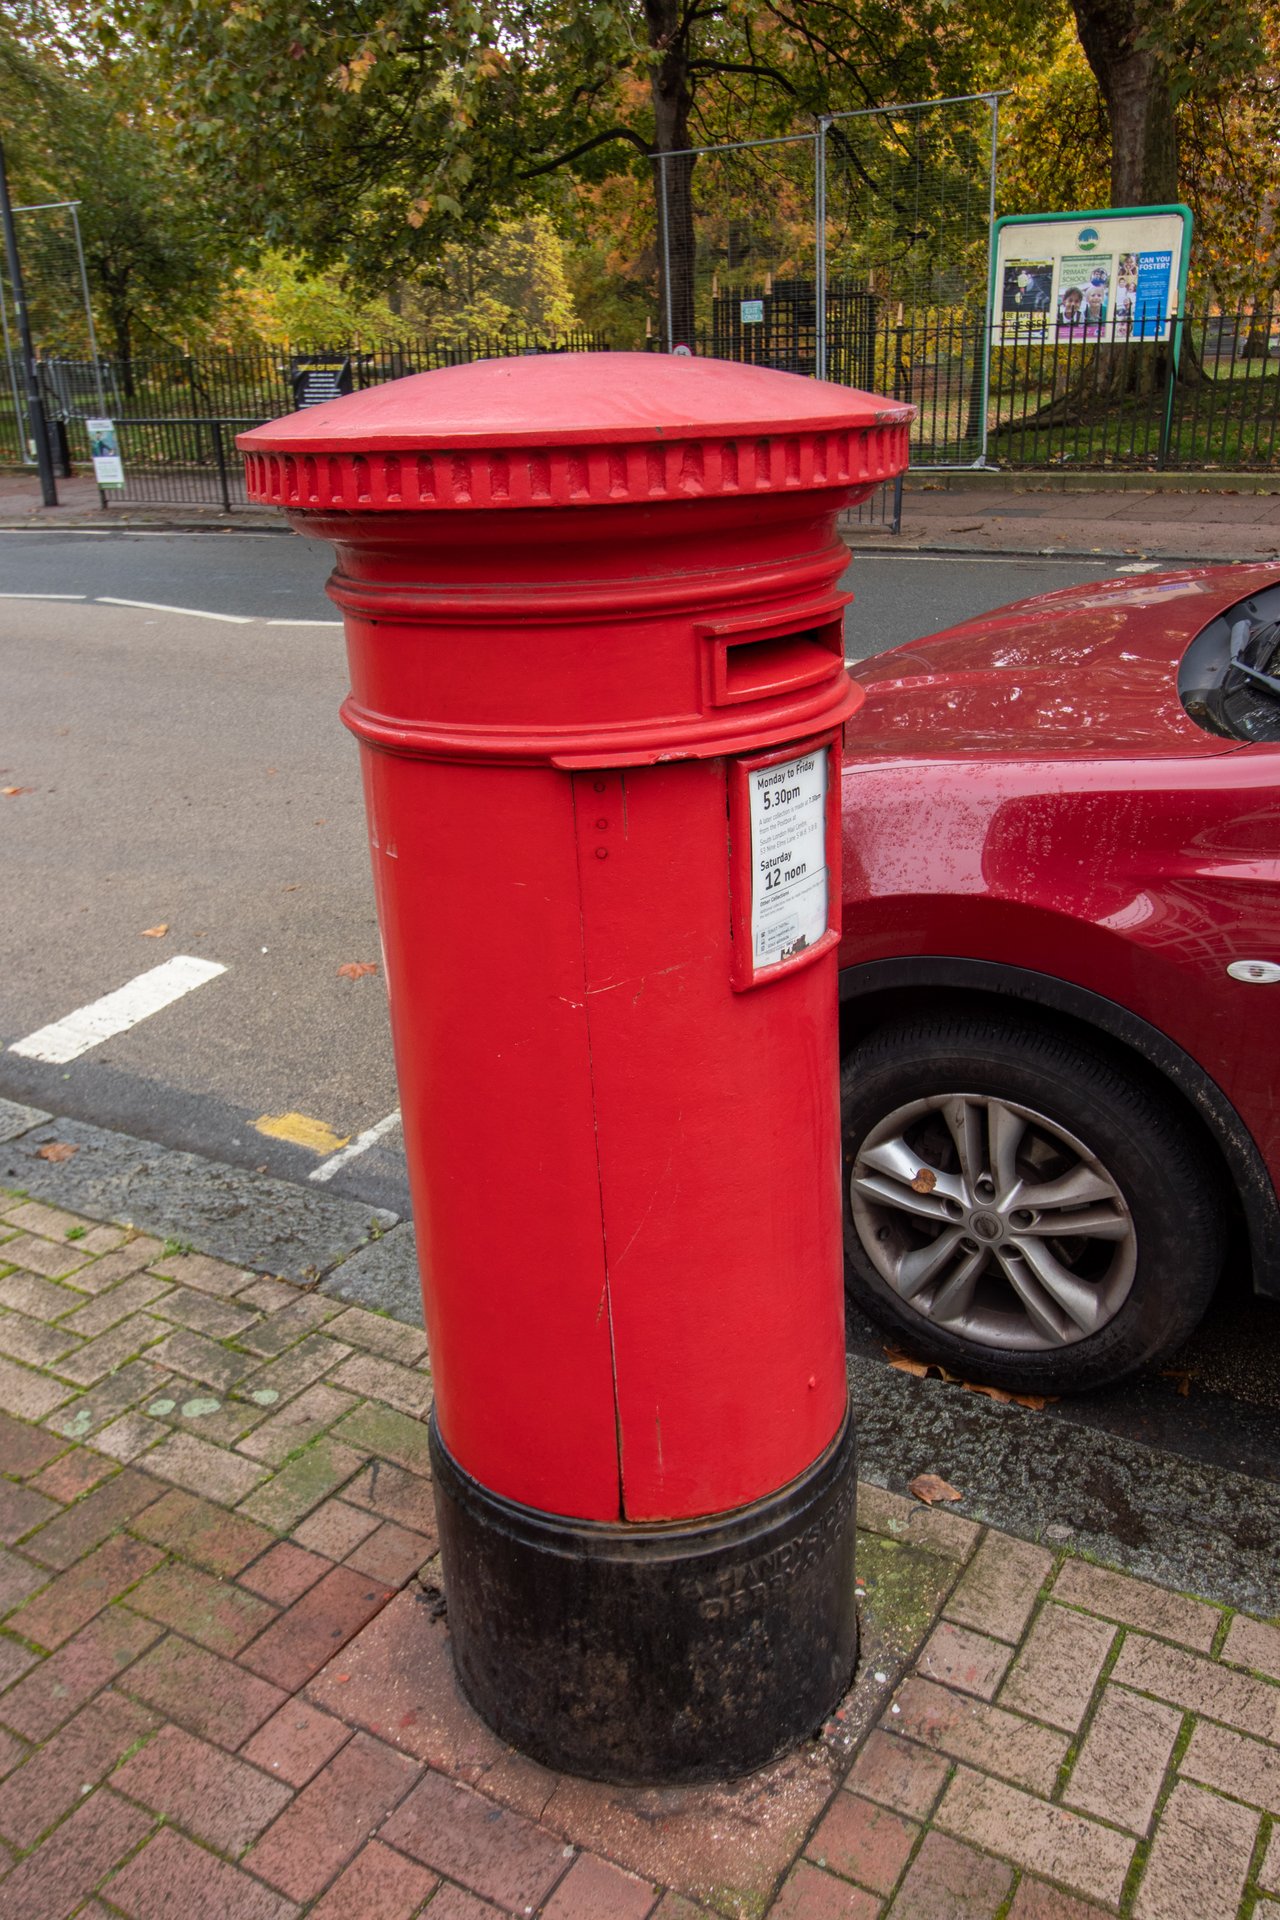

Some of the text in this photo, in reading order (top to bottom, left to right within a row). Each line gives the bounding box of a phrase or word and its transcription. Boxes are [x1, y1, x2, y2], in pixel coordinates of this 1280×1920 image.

[1139, 263, 1170, 271] FOSTER?
[1140, 255, 1171, 264] CAN YOU
[757, 773, 786, 790] Monday
[787, 769, 795, 779] to
[796, 760, 815, 775] Friday
[763, 786, 801, 810] 5.30pm
[773, 809, 790, 820] collection
[759, 826, 769, 835] from
[760, 836, 771, 846] South
[773, 830, 787, 841] London
[787, 835, 796, 844] Lane
[760, 851, 792, 871] Saturday
[765, 867, 781, 890] 12
[784, 862, 807, 882] noon
[760, 899, 770, 908] Other
[771, 889, 790, 903] Collections
